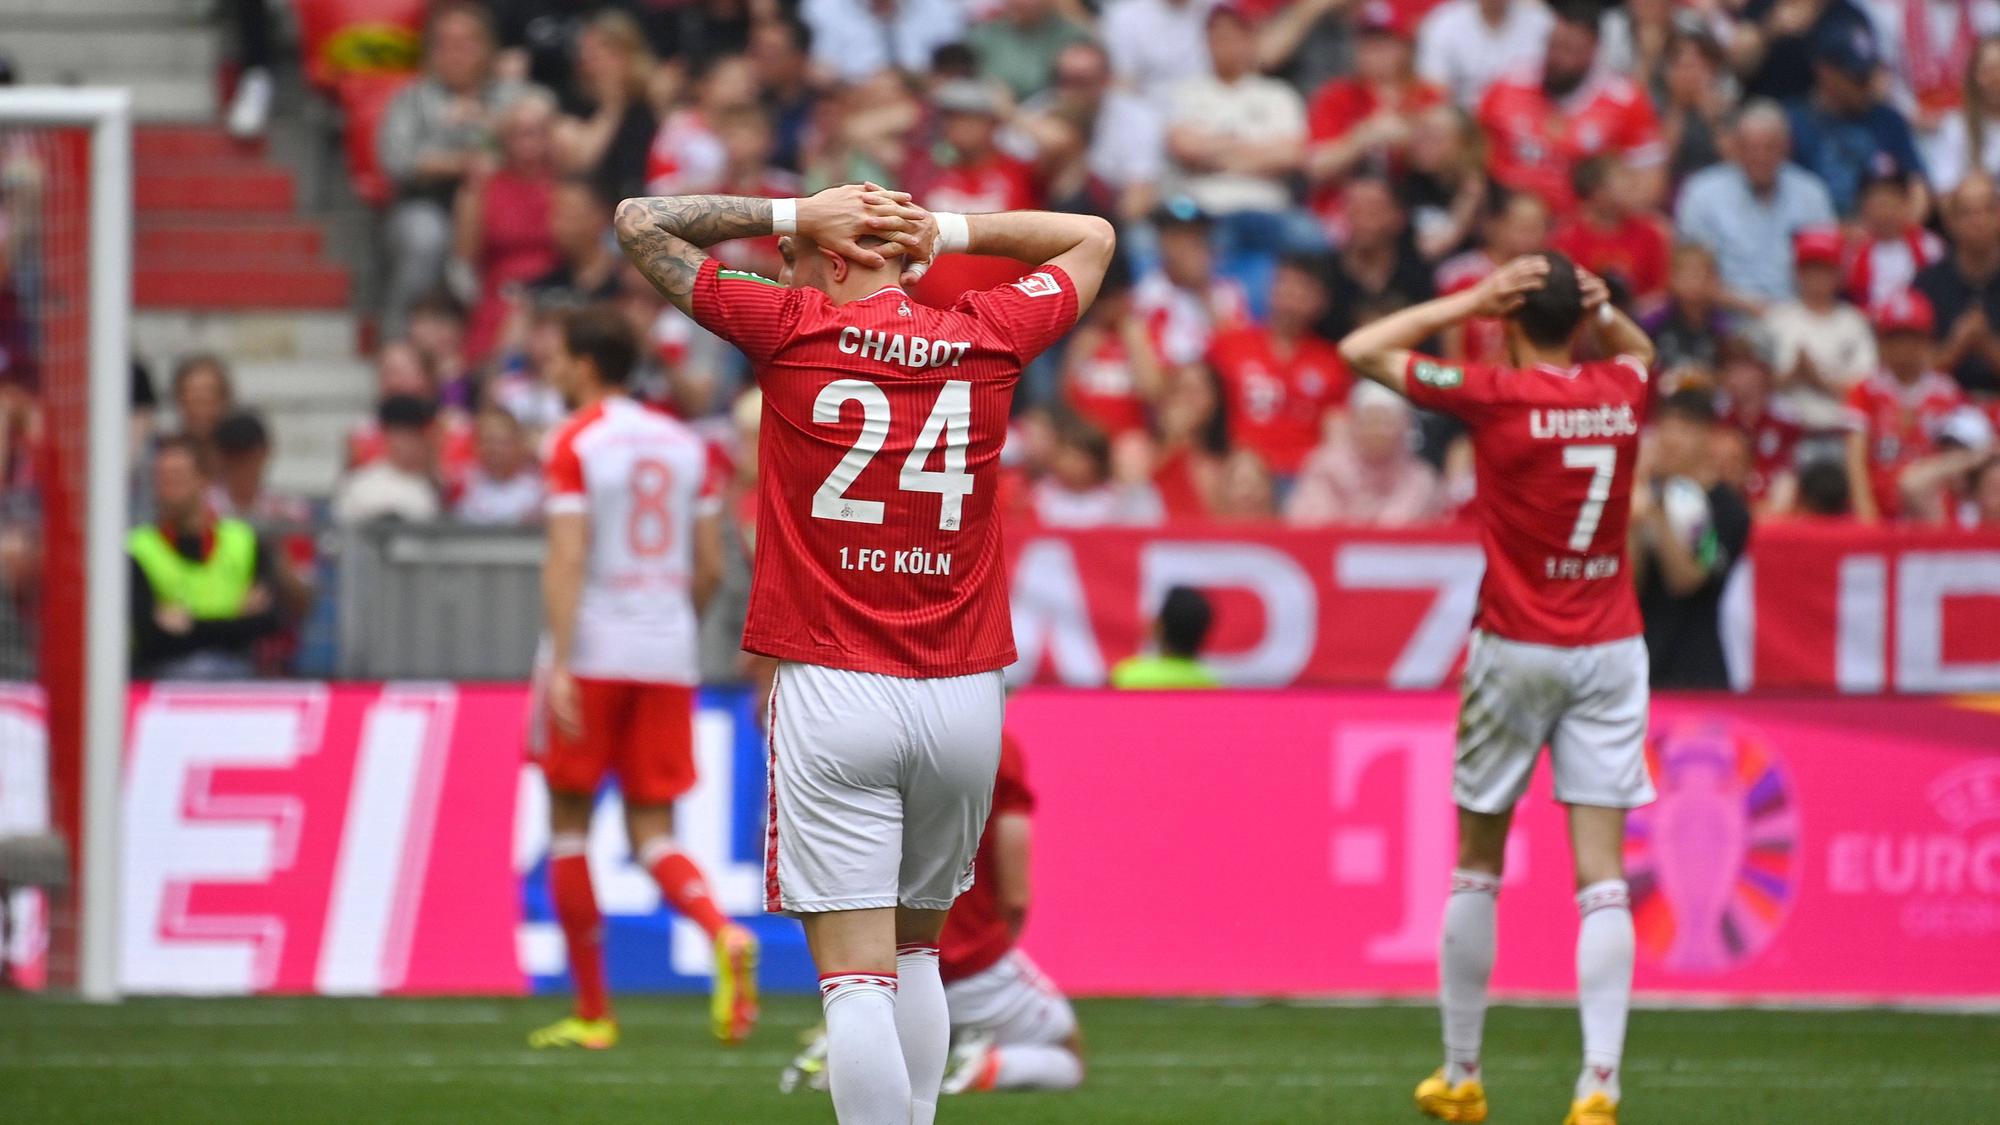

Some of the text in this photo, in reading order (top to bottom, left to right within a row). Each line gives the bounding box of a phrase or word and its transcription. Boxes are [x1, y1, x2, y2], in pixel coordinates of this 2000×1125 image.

[838, 326, 971, 368] CHABOT
[811, 379, 974, 531] 24
[1562, 445, 1617, 552] 7
[627, 458, 674, 558] 8
[894, 546, 952, 576] KÖLN
